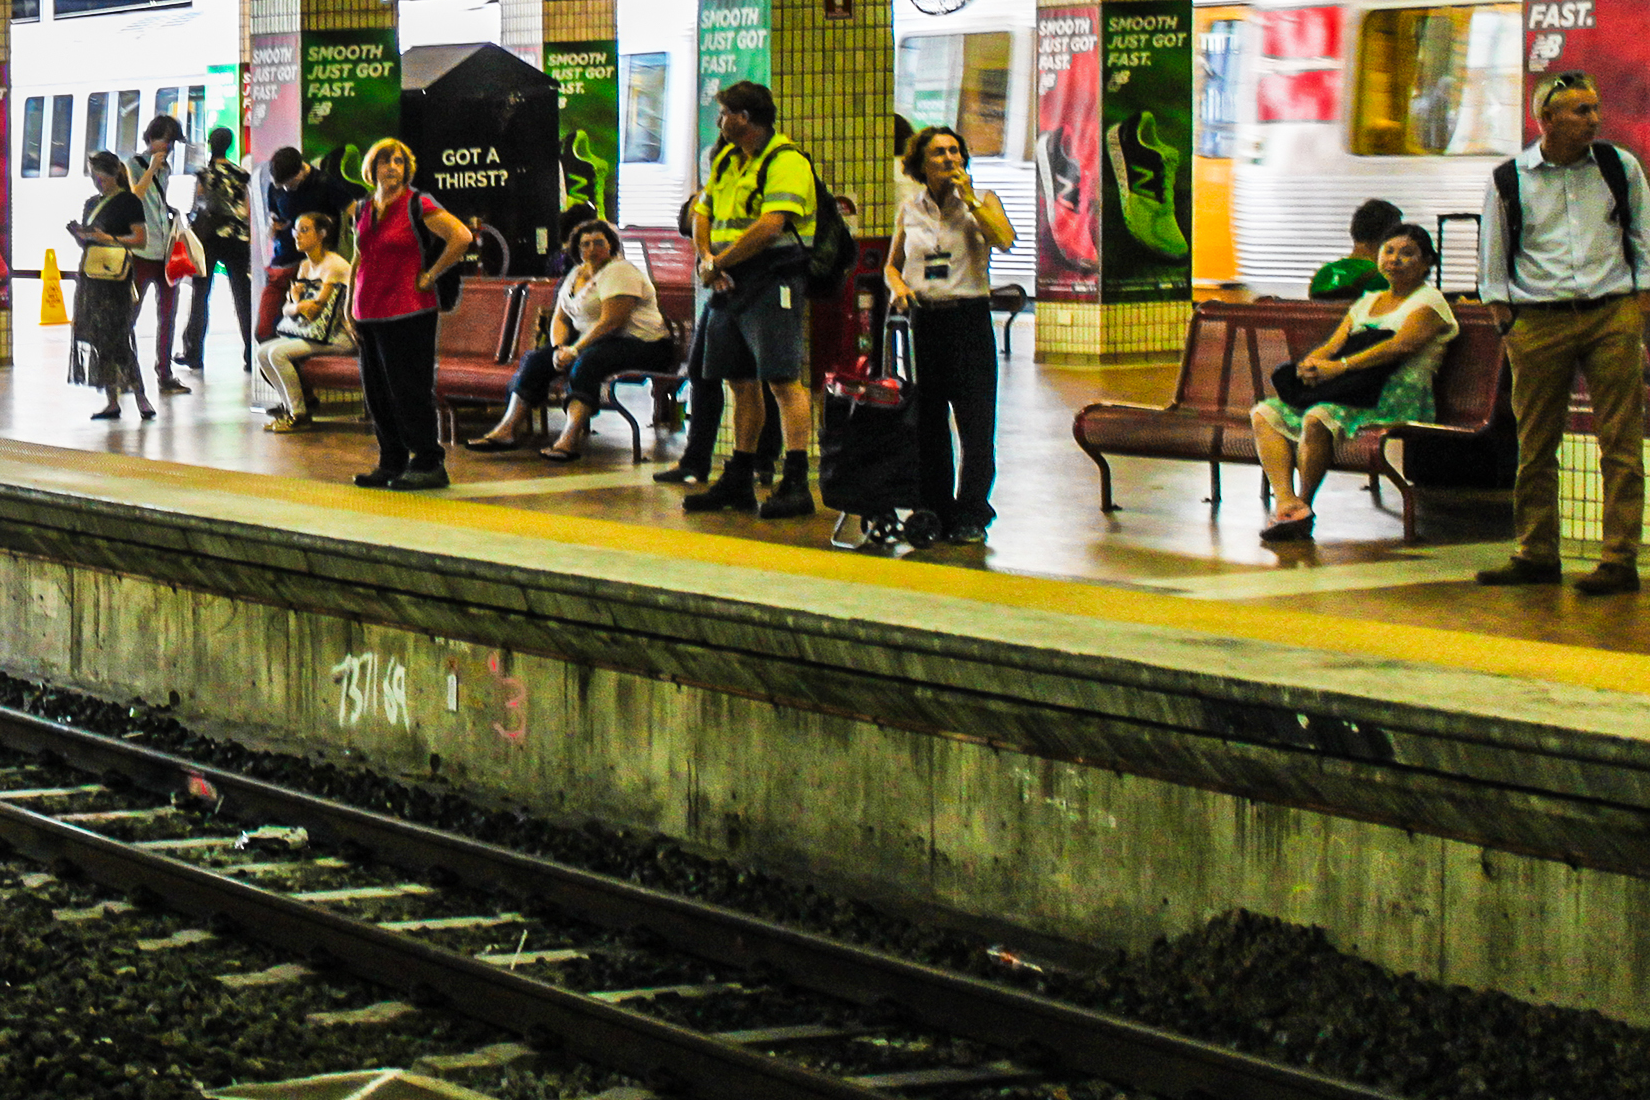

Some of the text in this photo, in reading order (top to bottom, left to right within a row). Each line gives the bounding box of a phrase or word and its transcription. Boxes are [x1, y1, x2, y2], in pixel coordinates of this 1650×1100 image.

[700, 7, 760, 29] SMOOTH
[1107, 15, 1179, 32] SMOOTH
[1528, 1, 1593, 30] FAST.
[1039, 17, 1092, 36] SMOOTH
[700, 28, 768, 52] JUST GOT
[1039, 35, 1098, 53] JUST GOT
[1107, 32, 1188, 50] JUST GOT
[252, 46, 293, 64] SMOOTH
[307, 44, 384, 62] SMOOTH
[547, 51, 608, 67] SMOOTH
[1038, 53, 1071, 71] FAST.
[1107, 51, 1152, 68] FAST.
[252, 63, 298, 83] JUST GOT
[307, 61, 395, 80] JUST GOT
[551, 65, 616, 81] JUST GOT
[700, 54, 737, 74] FAST.
[307, 81, 356, 98] FAST.
[557, 81, 586, 95] AST.
[441, 145, 501, 167] GOT A
[434, 168, 509, 190] THIRST?
